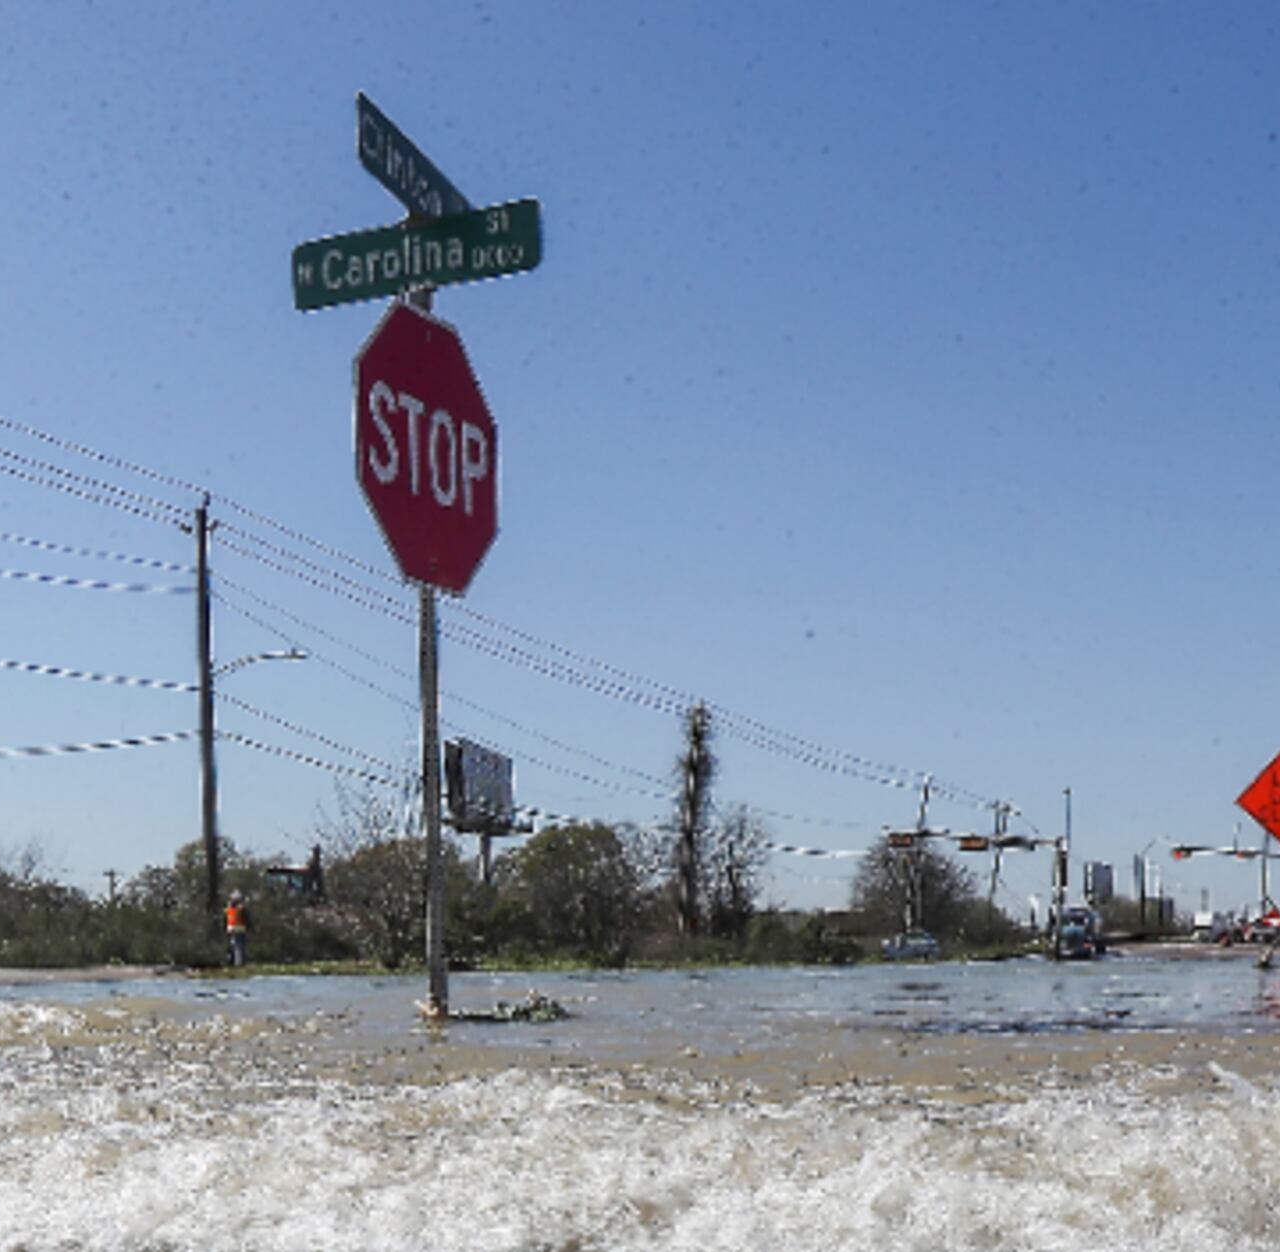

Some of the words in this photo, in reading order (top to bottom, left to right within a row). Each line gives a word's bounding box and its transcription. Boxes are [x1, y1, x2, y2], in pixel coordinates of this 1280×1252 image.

[322, 235, 464, 290] Carolina
[486, 208, 510, 235] St
[370, 380, 488, 516] STOP
